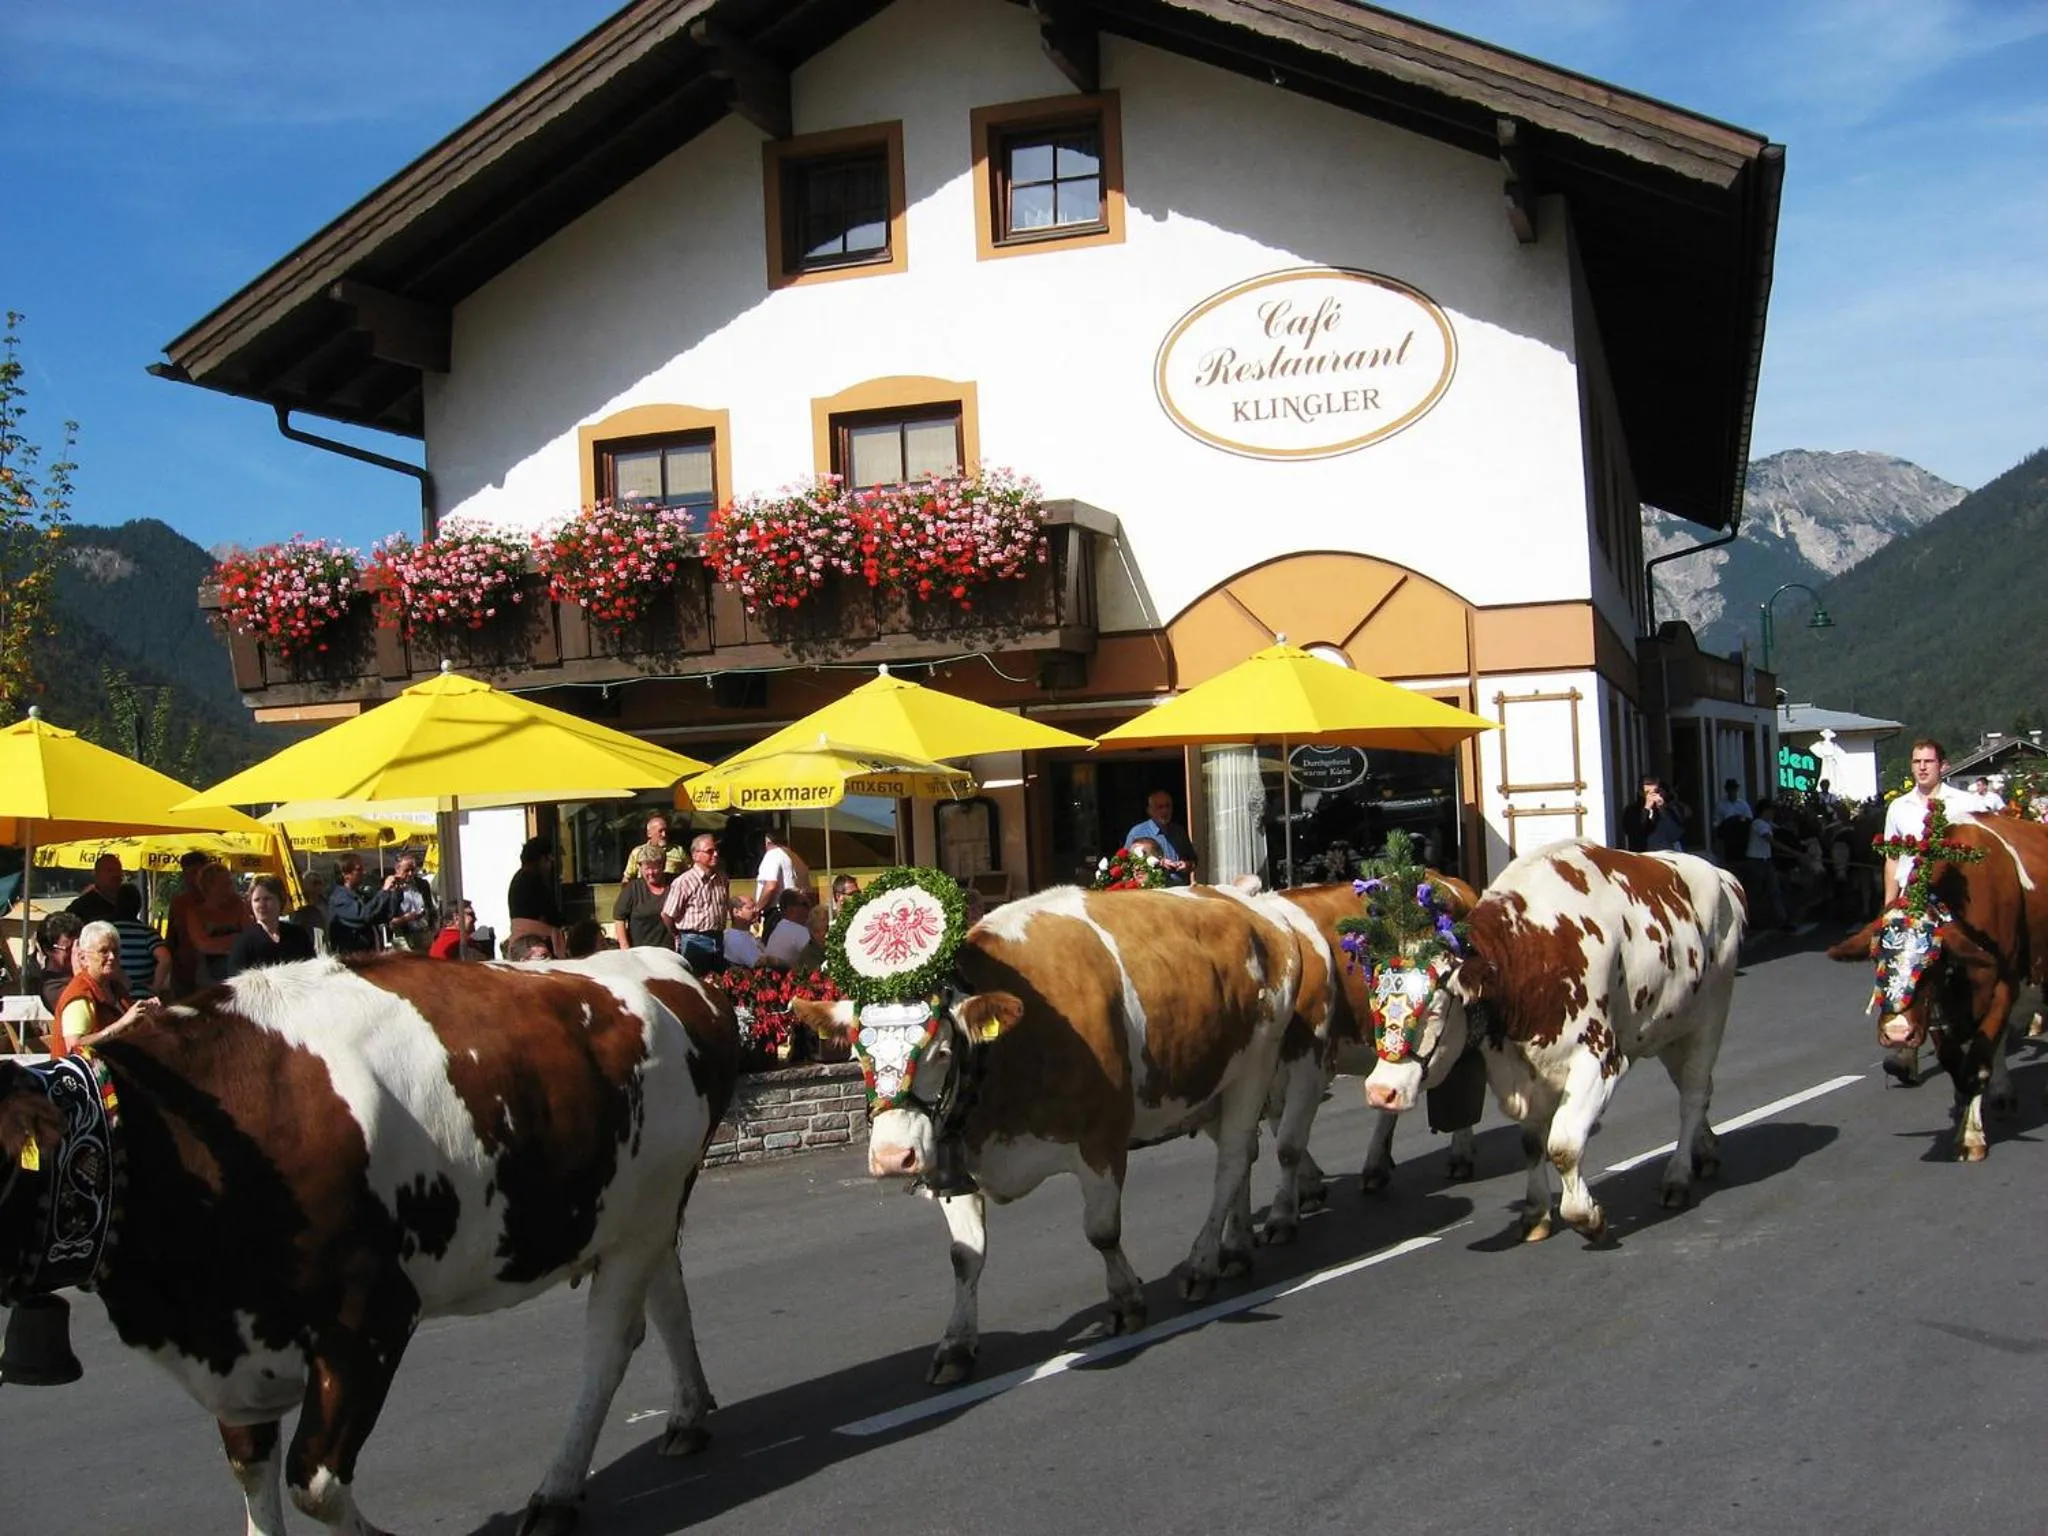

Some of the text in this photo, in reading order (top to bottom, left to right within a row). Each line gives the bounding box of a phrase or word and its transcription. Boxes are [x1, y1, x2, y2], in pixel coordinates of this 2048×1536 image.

[1257, 295, 1342, 351] Café
[1194, 330, 1415, 388] Restaurant
[1232, 387, 1382, 424] KLINGLER
[740, 785, 836, 807] praxmarer
